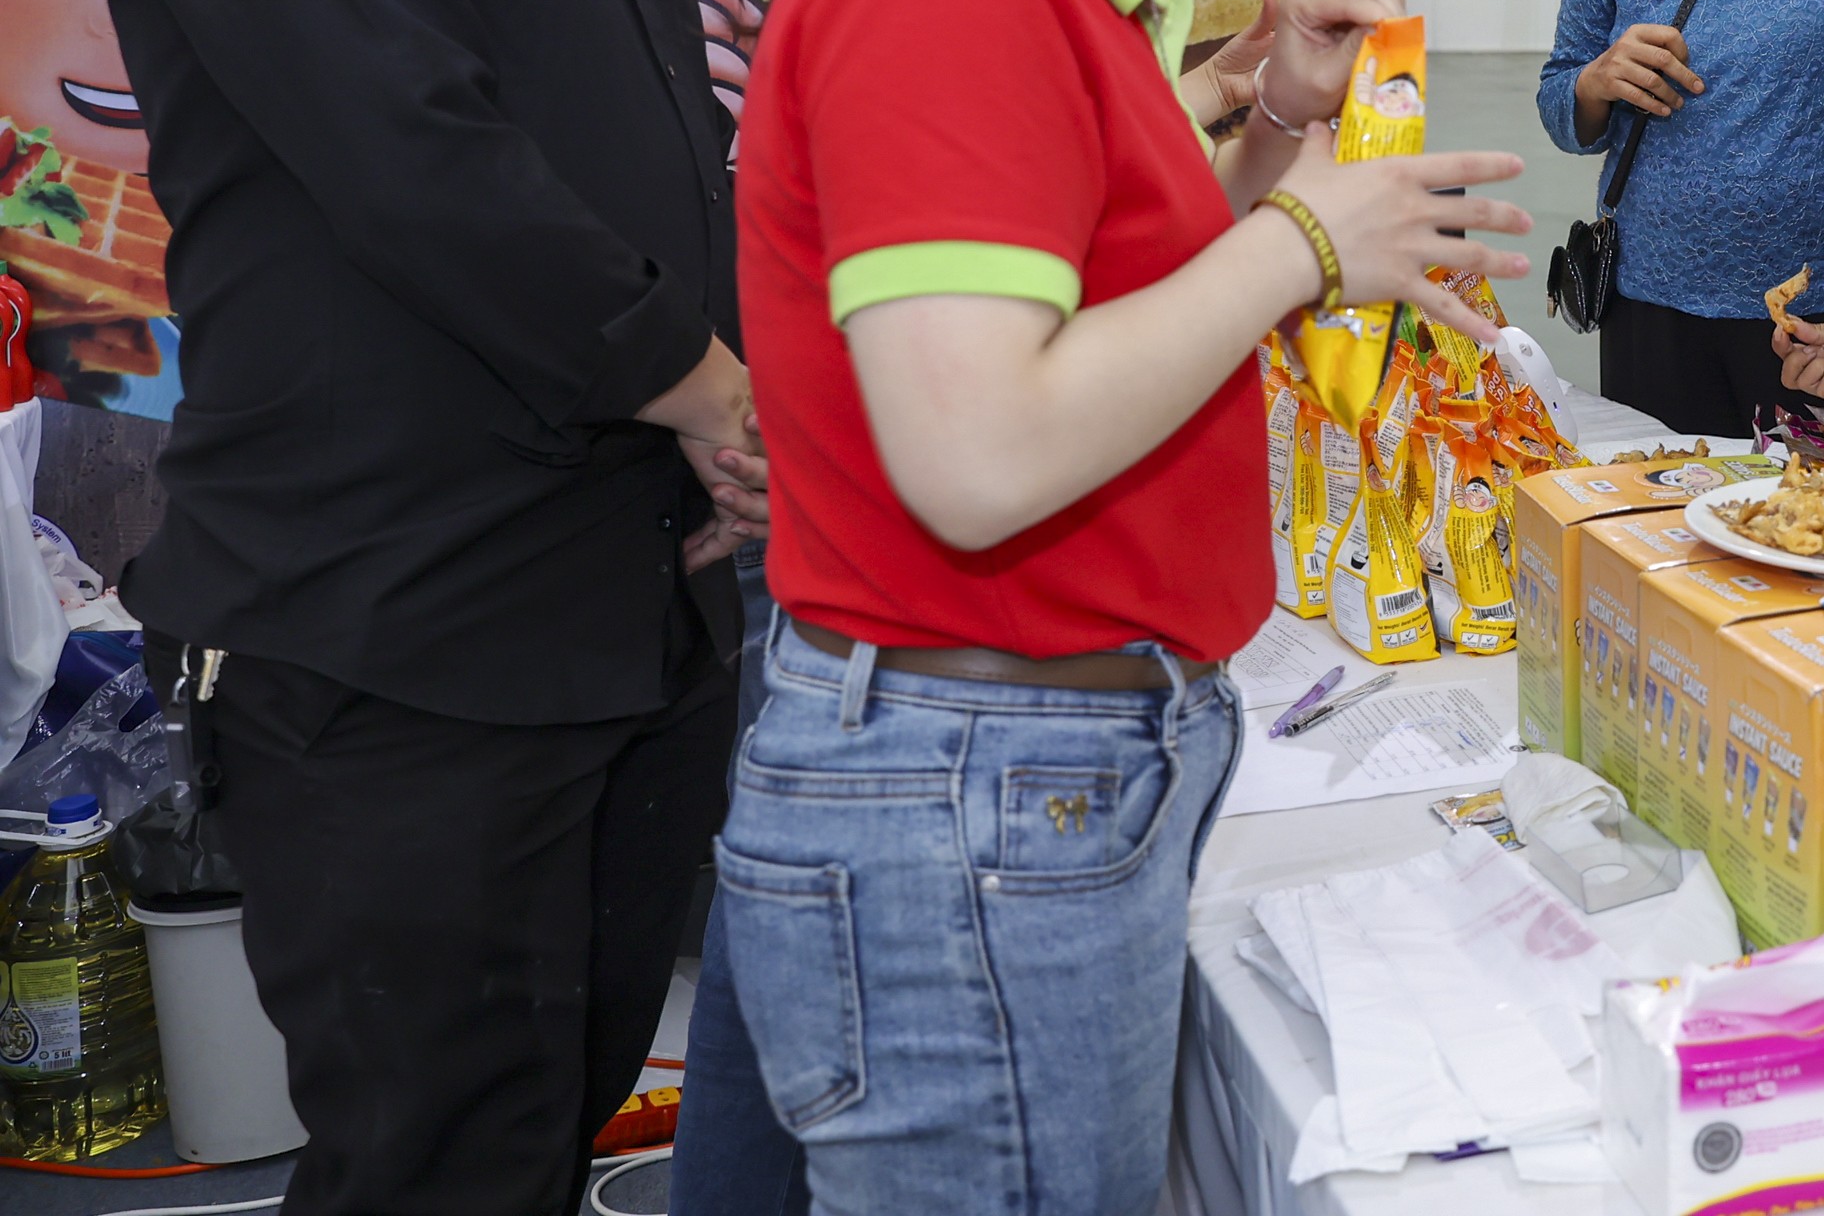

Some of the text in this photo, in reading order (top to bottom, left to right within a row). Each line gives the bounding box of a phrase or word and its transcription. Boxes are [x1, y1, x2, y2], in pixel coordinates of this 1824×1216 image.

[32, 518, 62, 544] System
[1521, 545, 1541, 577] INSTANT
[1588, 595, 1637, 648] INSTANT SAUCE
[1648, 648, 1709, 707] INSTANT SAUCE
[1729, 711, 1804, 779] INSTANT SAUCE
